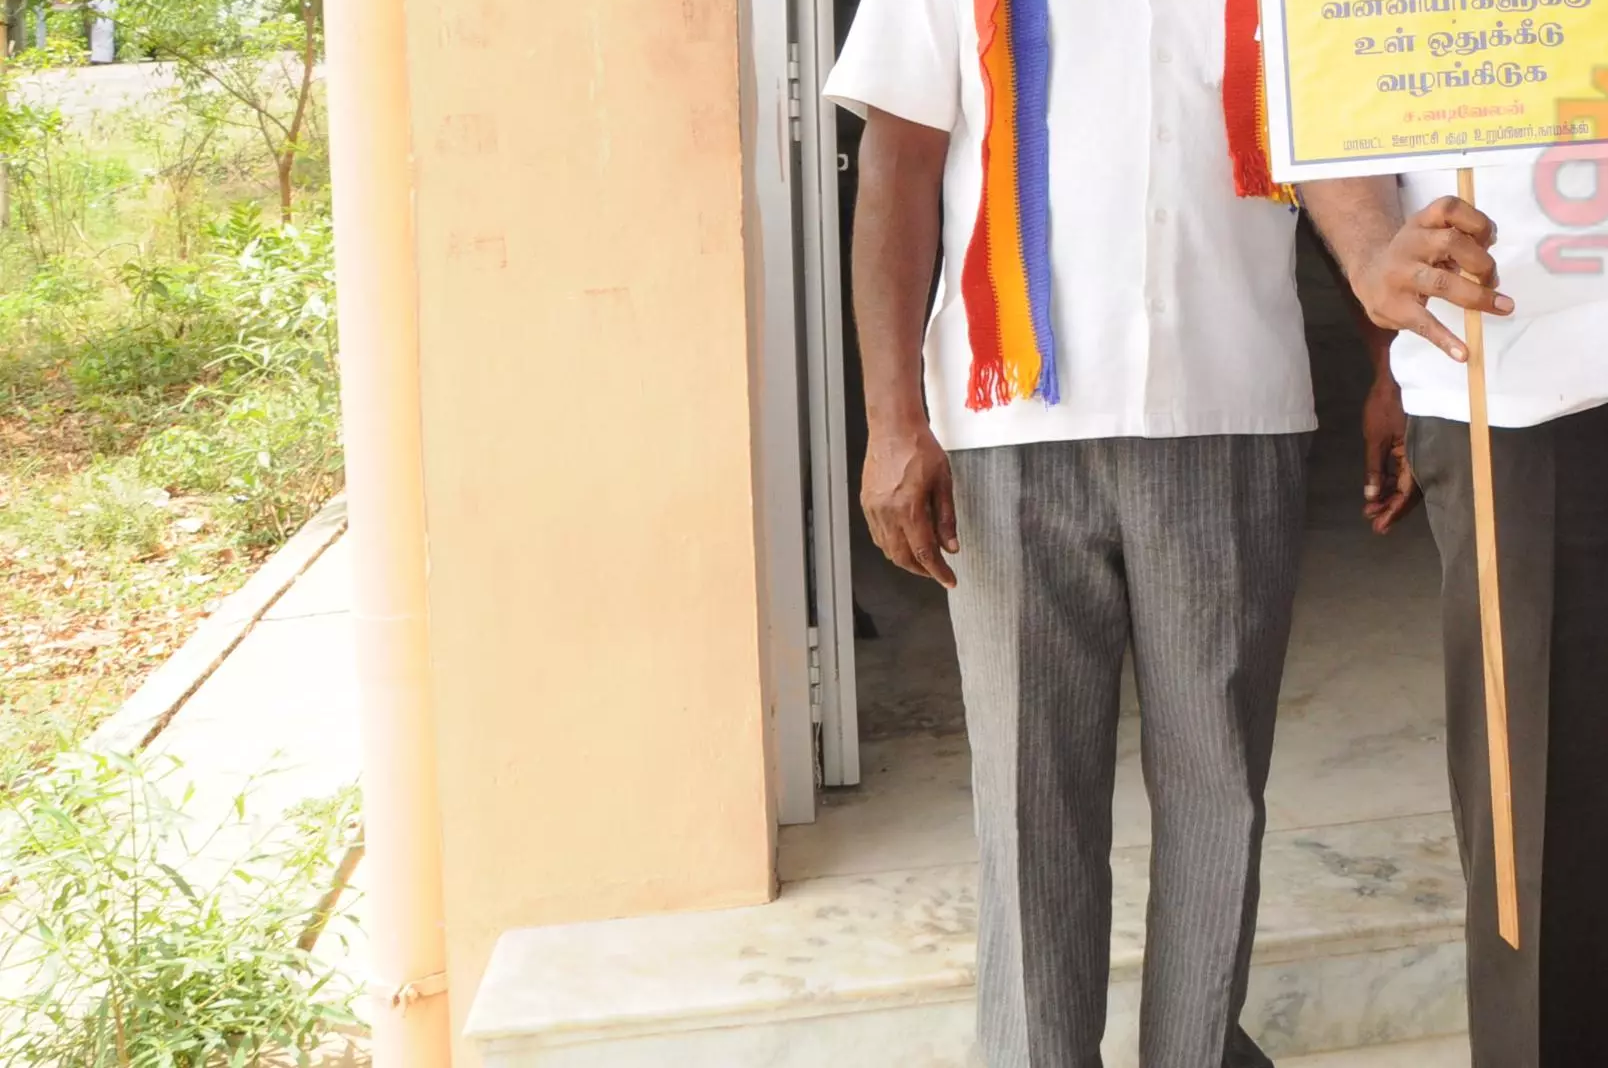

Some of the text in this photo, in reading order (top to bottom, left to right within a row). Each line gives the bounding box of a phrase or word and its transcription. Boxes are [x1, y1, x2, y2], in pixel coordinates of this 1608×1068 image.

[1354, 20, 1564, 57] உள் ஒதுக்கீடு
[1376, 61, 1548, 97] வழங்கிடுக
